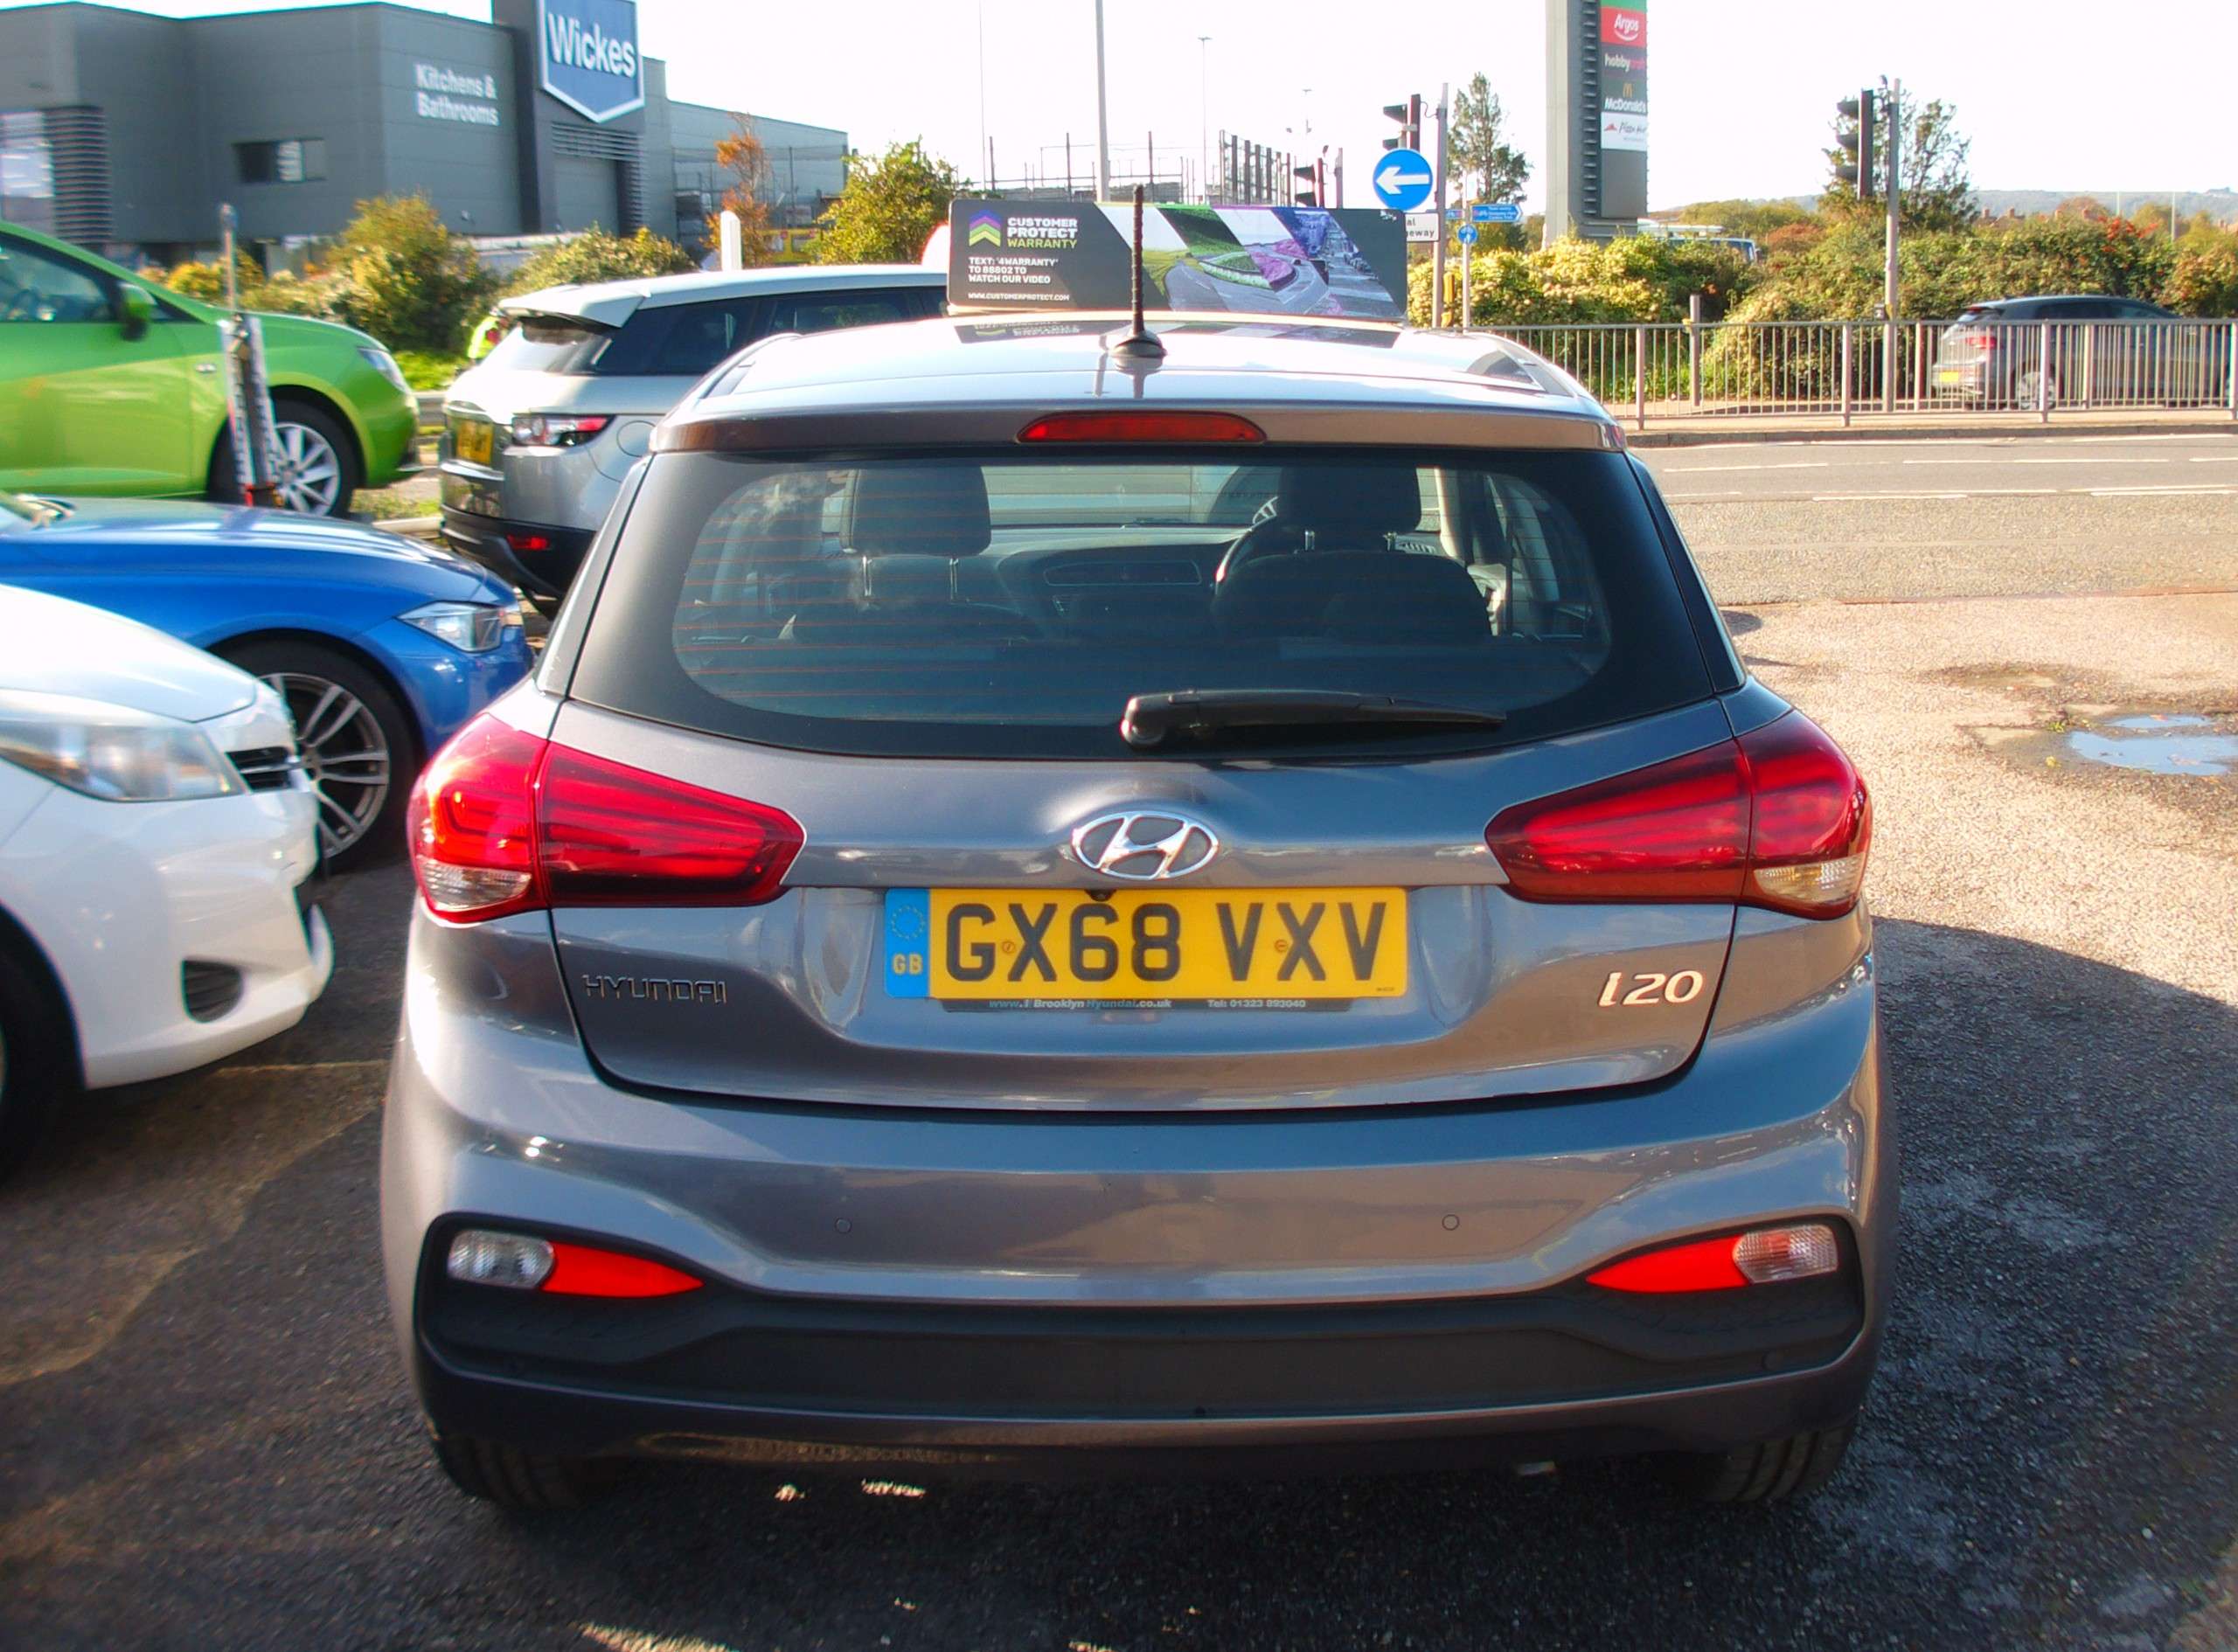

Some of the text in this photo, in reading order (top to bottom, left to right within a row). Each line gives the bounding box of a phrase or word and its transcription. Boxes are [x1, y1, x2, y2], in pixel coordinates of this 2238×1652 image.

[1614, 14, 1639, 34] Argos
[548, 13, 636, 78] Wickes
[415, 63, 497, 100] Kitchens &
[417, 91, 500, 126] Bathrooms
[1007, 217, 1078, 227] CUSTOMER
[1007, 227, 1078, 239] PROTECT
[1007, 239, 1078, 249] WARRANTY
[1023, 275, 1051, 284] VIDEO
[946, 902, 1387, 982] GX68 VXV
[893, 954, 923, 975] GB
[582, 975, 727, 1004] HYUNDAI
